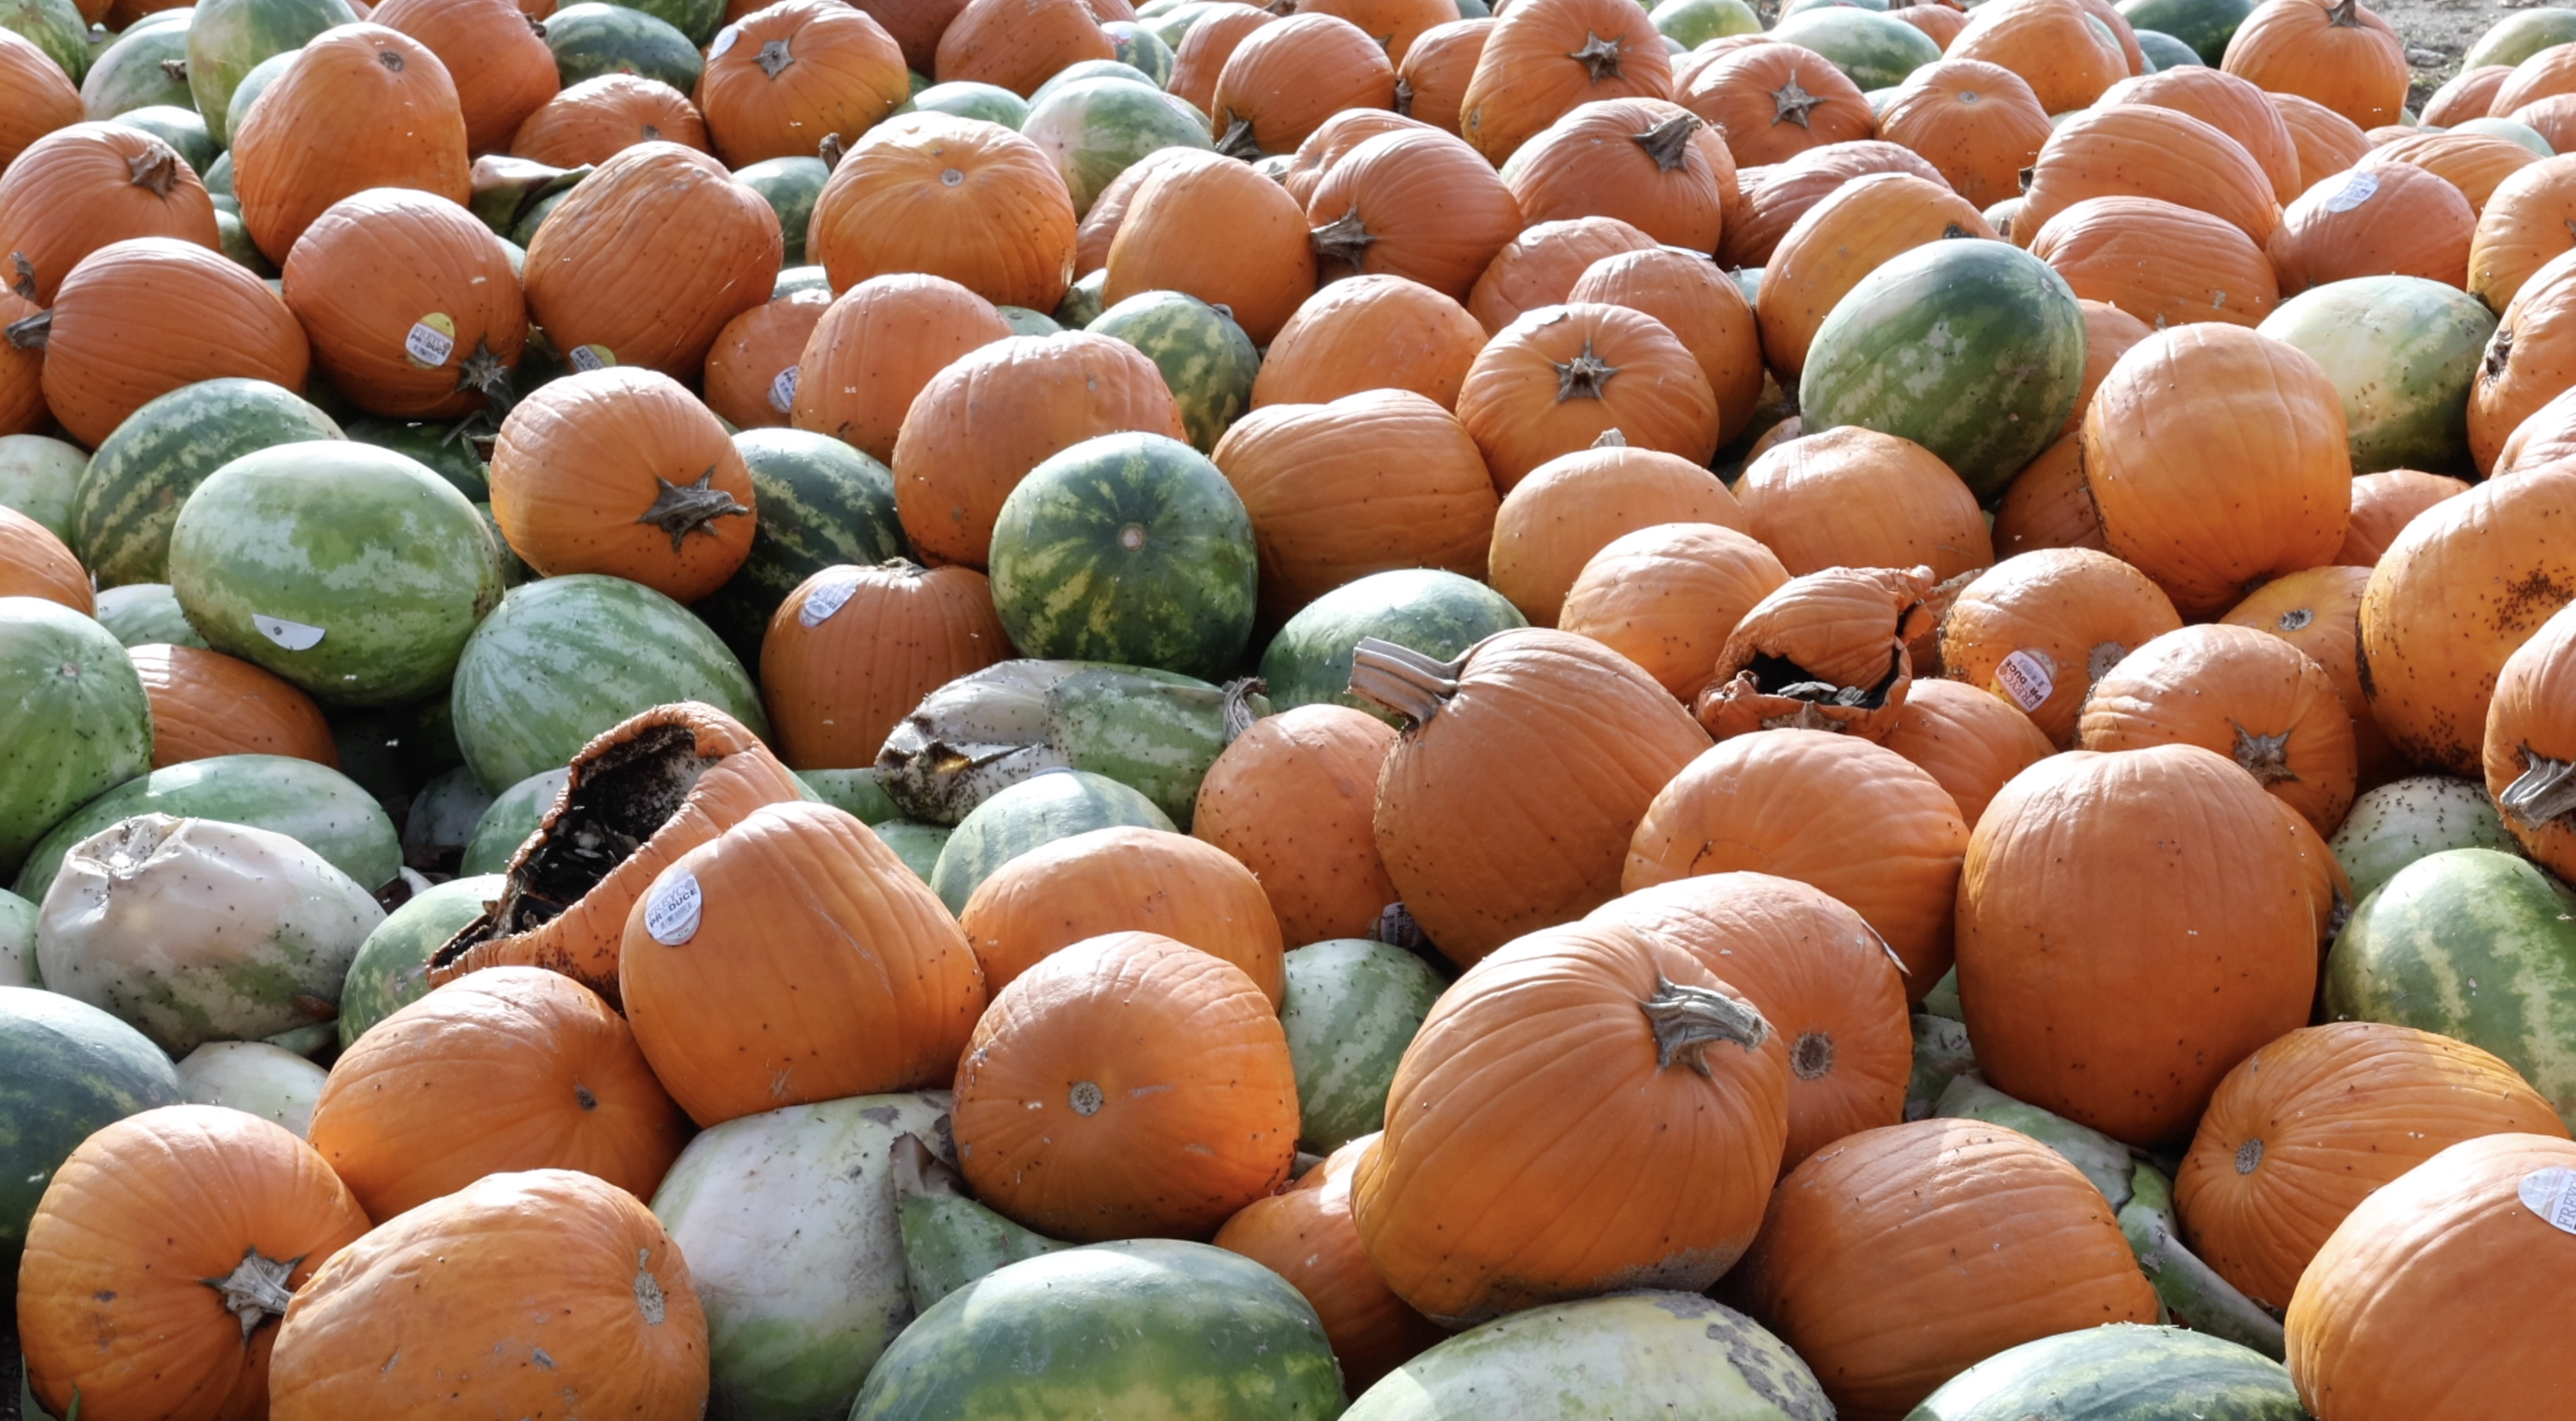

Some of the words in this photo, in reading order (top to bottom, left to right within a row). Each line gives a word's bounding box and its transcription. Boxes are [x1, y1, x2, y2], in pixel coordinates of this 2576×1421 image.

[411, 333, 447, 357] PRDUCE
[2004, 658, 2044, 702] PRDUCE
[649, 887, 697, 928] PRDUCE
